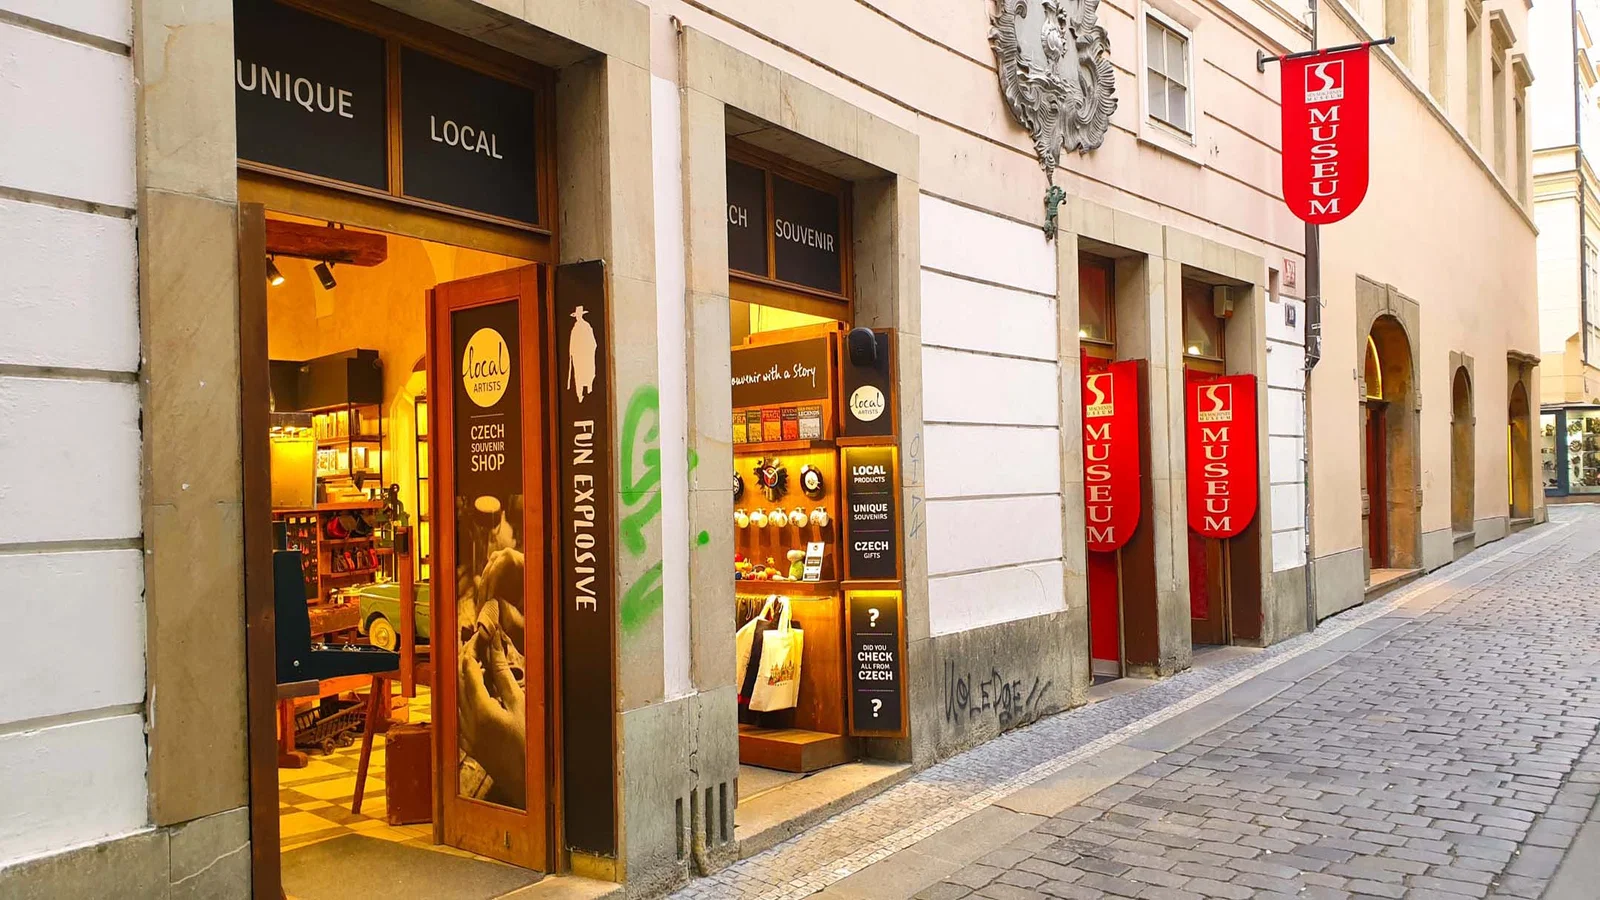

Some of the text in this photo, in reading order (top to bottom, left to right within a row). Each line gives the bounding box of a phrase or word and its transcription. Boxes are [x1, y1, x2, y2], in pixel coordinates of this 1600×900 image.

[236, 59, 354, 119] UNIQUE
[430, 115, 503, 160] LOCAL
[1308, 105, 1340, 215] MUSEUM
[727, 204, 747, 228] CH
[775, 218, 834, 252] SOUVENIR
[462, 341, 509, 380] local
[731, 362, 816, 388] ouvenir with a Story
[473, 381, 501, 393] ARTISTS
[849, 392, 884, 409] local
[471, 423, 505, 440] CZECH
[471, 441, 505, 453] SOUVENIR
[471, 453, 505, 472] SHOP
[852, 465, 886, 476] LOCAL
[1086, 423, 1116, 543] MUSEUM
[1201, 427, 1232, 531] MUSEUM
[573, 420, 597, 612] FUN EXPLOSIVE
[853, 503, 888, 513] UNIQUE
[854, 513, 888, 521] SOUVENIRS
[854, 541, 889, 551] CZECH
[868, 608, 880, 628] ?
[857, 651, 893, 662] CHECK
[858, 670, 893, 681] CZECH
[871, 698, 882, 718] ?
